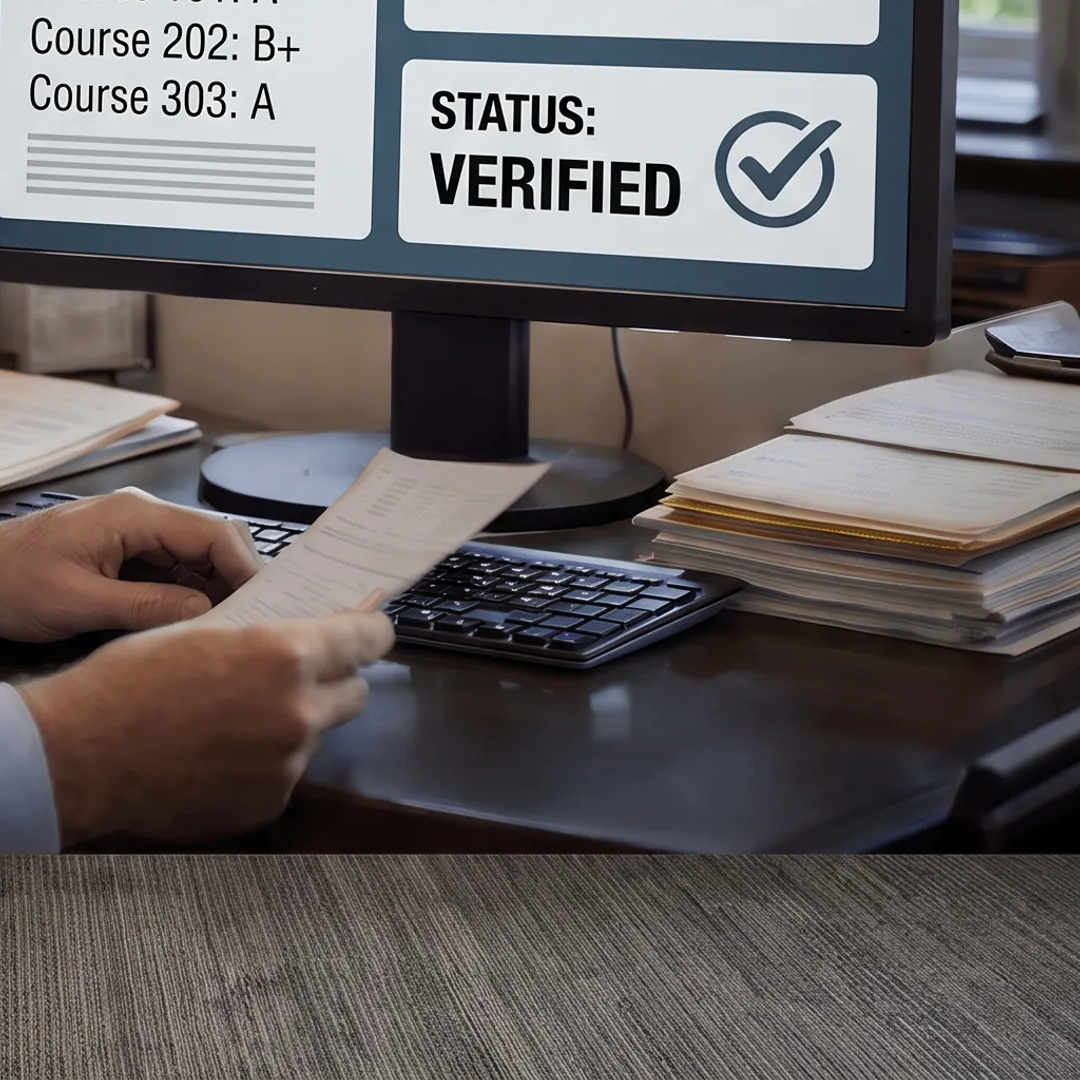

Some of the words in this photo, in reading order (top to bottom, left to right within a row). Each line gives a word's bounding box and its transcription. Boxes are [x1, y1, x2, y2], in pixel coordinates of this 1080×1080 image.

[32, 18, 149, 57] Course
[163, 22, 237, 60] 202:
[255, 25, 299, 62] B+
[30, 74, 148, 114] Course
[162, 80, 236, 118] 303:
[251, 83, 275, 120] A
[432, 91, 594, 135] STATUS:
[430, 153, 680, 216] VERIFIED
